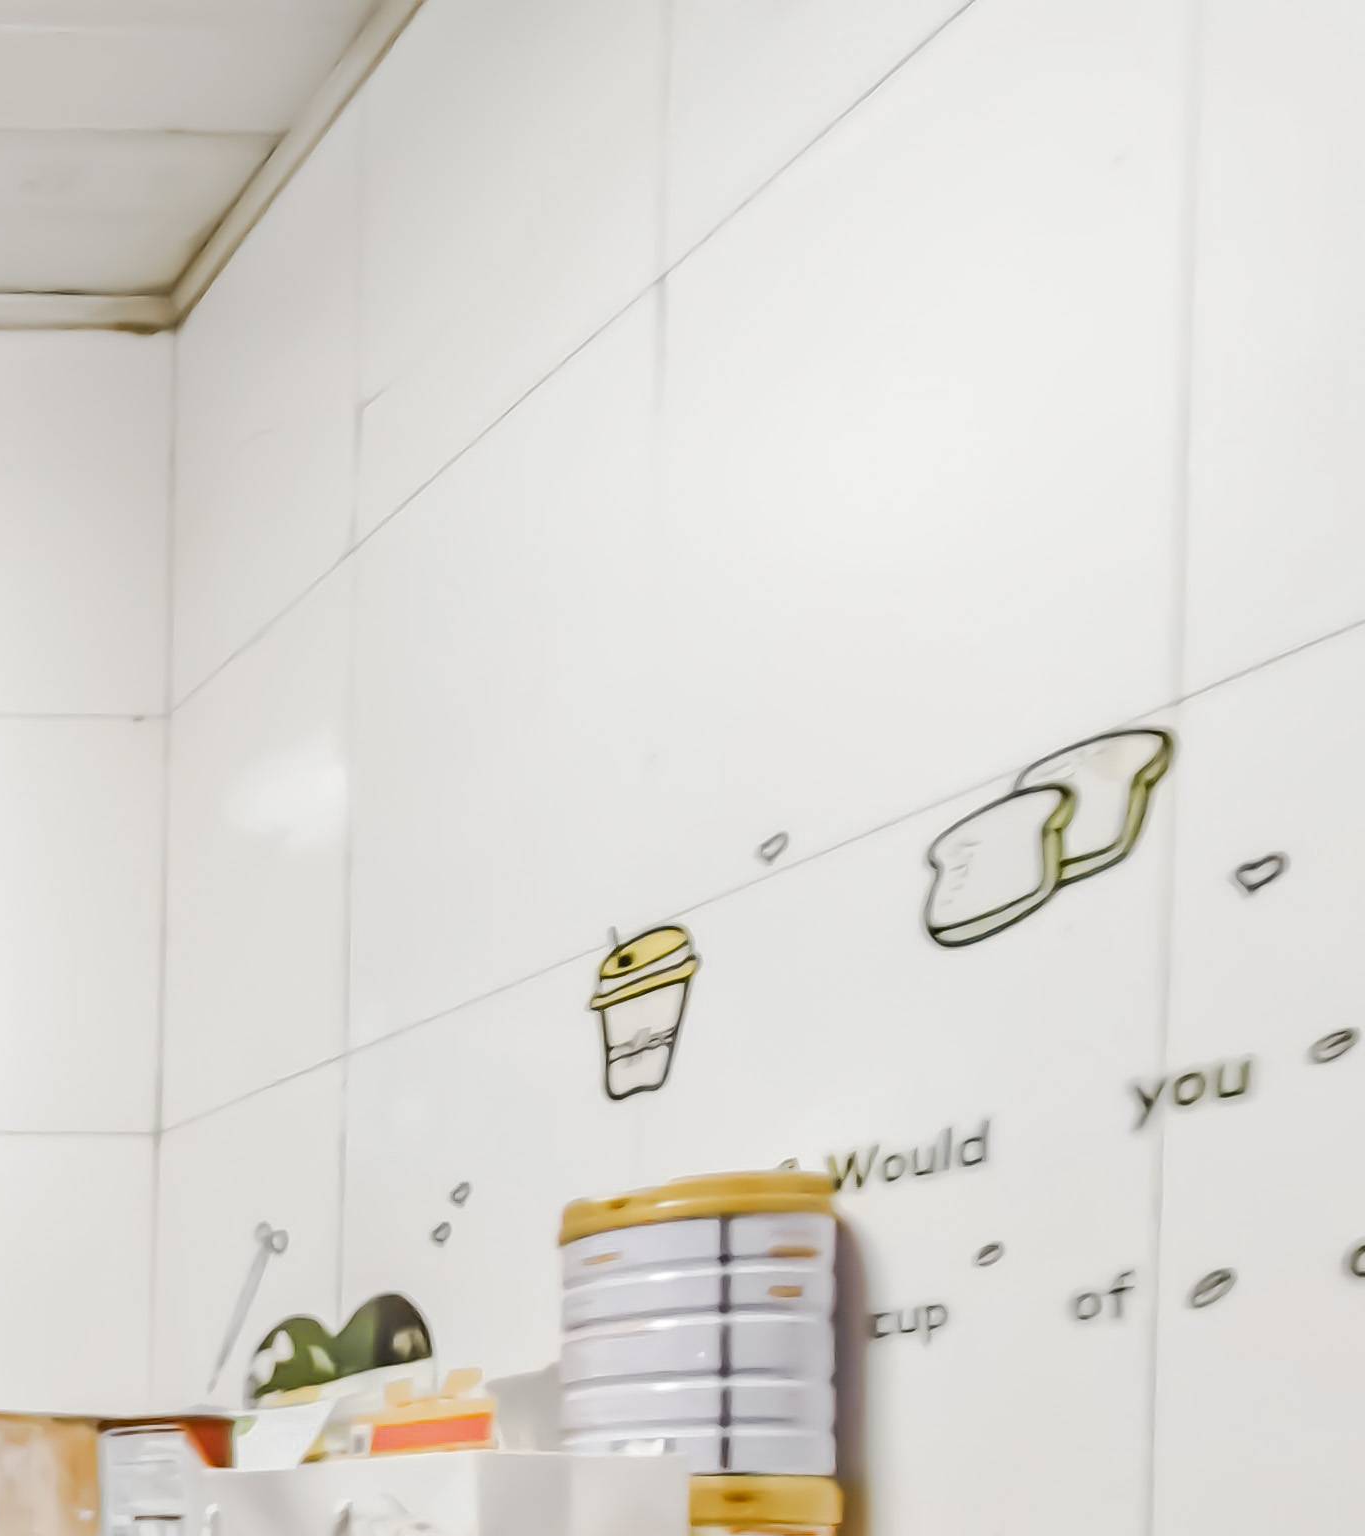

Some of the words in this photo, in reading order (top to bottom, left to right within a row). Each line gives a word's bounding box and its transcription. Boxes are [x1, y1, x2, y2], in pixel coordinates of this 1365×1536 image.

[827, 1118, 990, 1191] Would
[1130, 1058, 1252, 1130] you
[870, 1303, 949, 1345] cup
[1072, 1268, 1137, 1321] of
